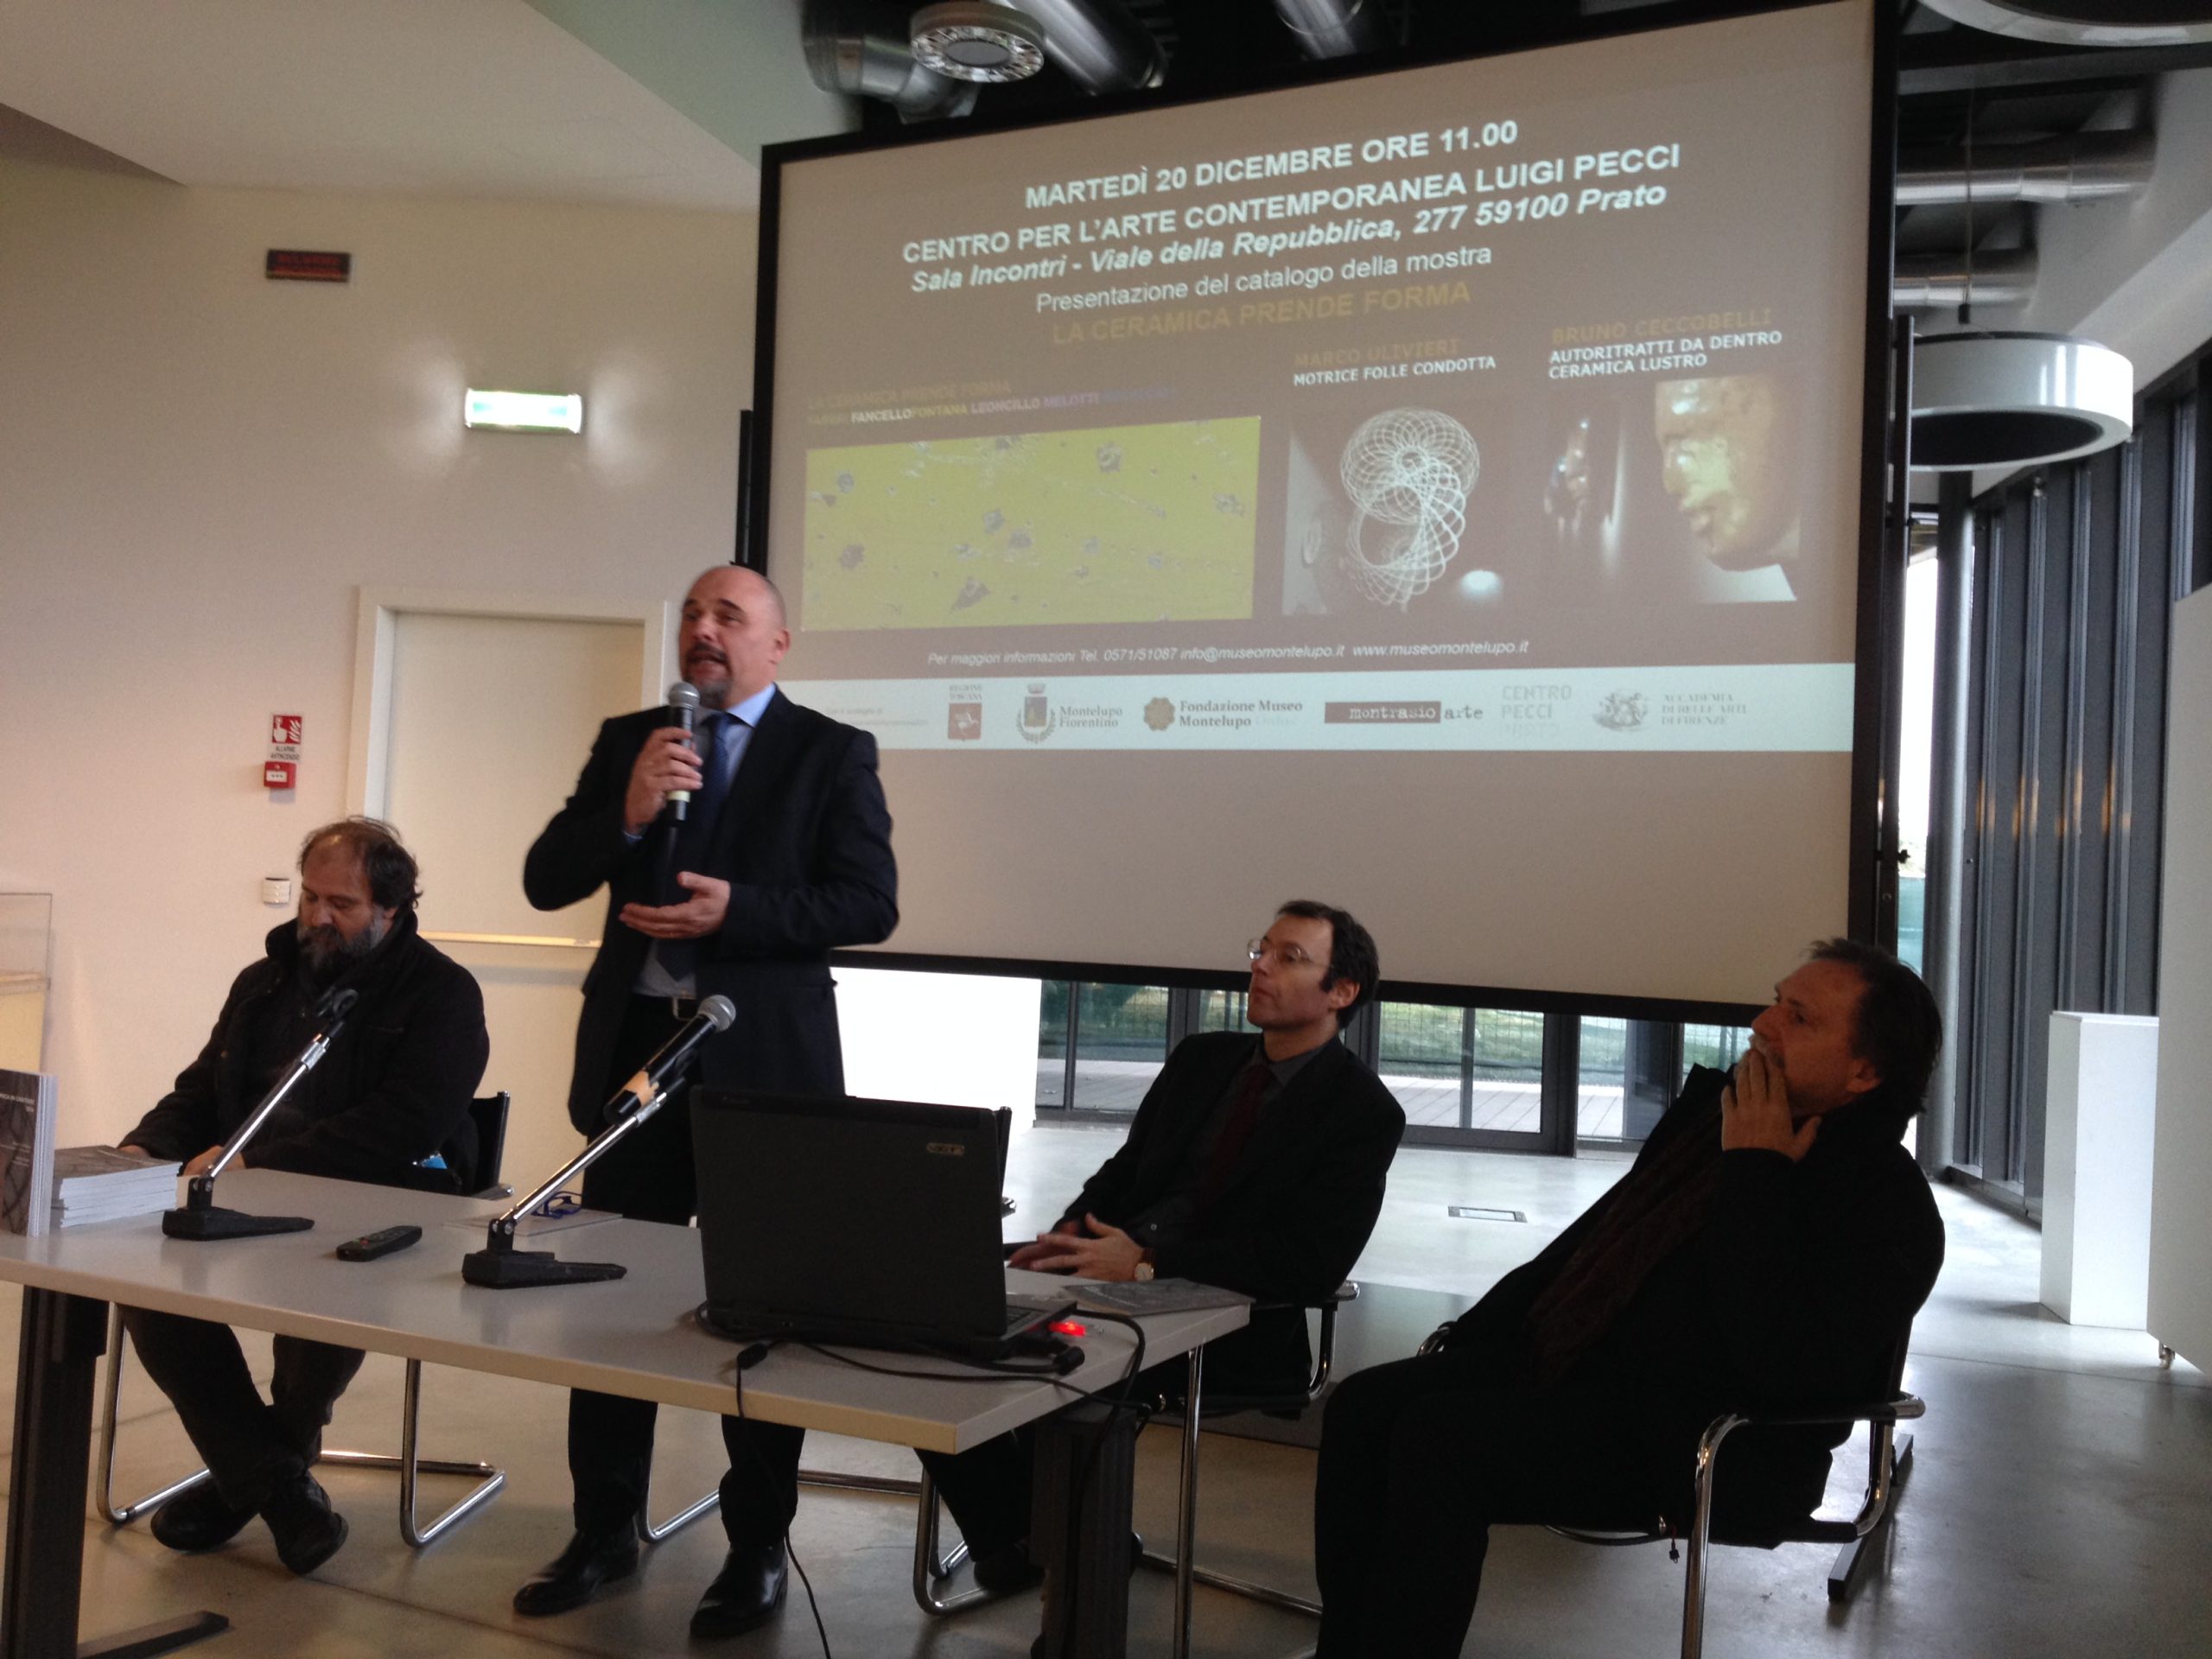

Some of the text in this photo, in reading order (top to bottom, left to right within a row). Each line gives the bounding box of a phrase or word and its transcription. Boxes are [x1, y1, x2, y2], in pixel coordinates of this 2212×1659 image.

[1026, 121, 1518, 208] MARTEDÌ 20 DICEMBRE ORE 11.00
[903, 143, 1680, 263] CENTRO PER L'ARTE CONTEMPORANEA LUIGI PECCI
[912, 270, 963, 293] Sala
[970, 256, 1065, 286] Incontri
[1090, 247, 1150, 273] Viale
[1160, 238, 1224, 264] della
[1233, 213, 1402, 256] Repubblica,
[1413, 206, 1465, 234] 277
[1475, 193, 1568, 226] 59100
[1577, 183, 1667, 214] Prato
[1037, 247, 1492, 314] Presentazione del catalogo della mostra
[1053, 282, 1471, 345] LA CERAMICA PRENDE FORMA
[1552, 308, 1772, 345] BRUNO CECCOBELLI
[1294, 348, 1361, 368] MARCO
[1549, 330, 1783, 365] AUTORITRATTI DA DENTRO
[1293, 355, 1497, 386] MOTRICE FOLLE CONDOTTA
[1548, 353, 1707, 379] CERAMICA LUSTRO
[1044, 391, 1100, 409] MELOTTI
[928, 652, 948, 665] Per
[951, 651, 1001, 668] maggiori
[1003, 649, 1076, 664] informazioni
[1080, 648, 1100, 662] Tel.
[1180, 643, 1344, 663] info@museomontelupo.it
[1352, 640, 1529, 659] www.museomontelupo.it
[1503, 685, 1572, 701] CENTRO
[1059, 704, 1123, 721] Montelupo
[1179, 699, 1303, 714] Fondazione Museo
[1350, 705, 1484, 720] montrasio arte
[1502, 704, 1552, 720] PECCI
[1059, 715, 1119, 728] Fiorentino
[1179, 714, 1252, 729] Montelupo
